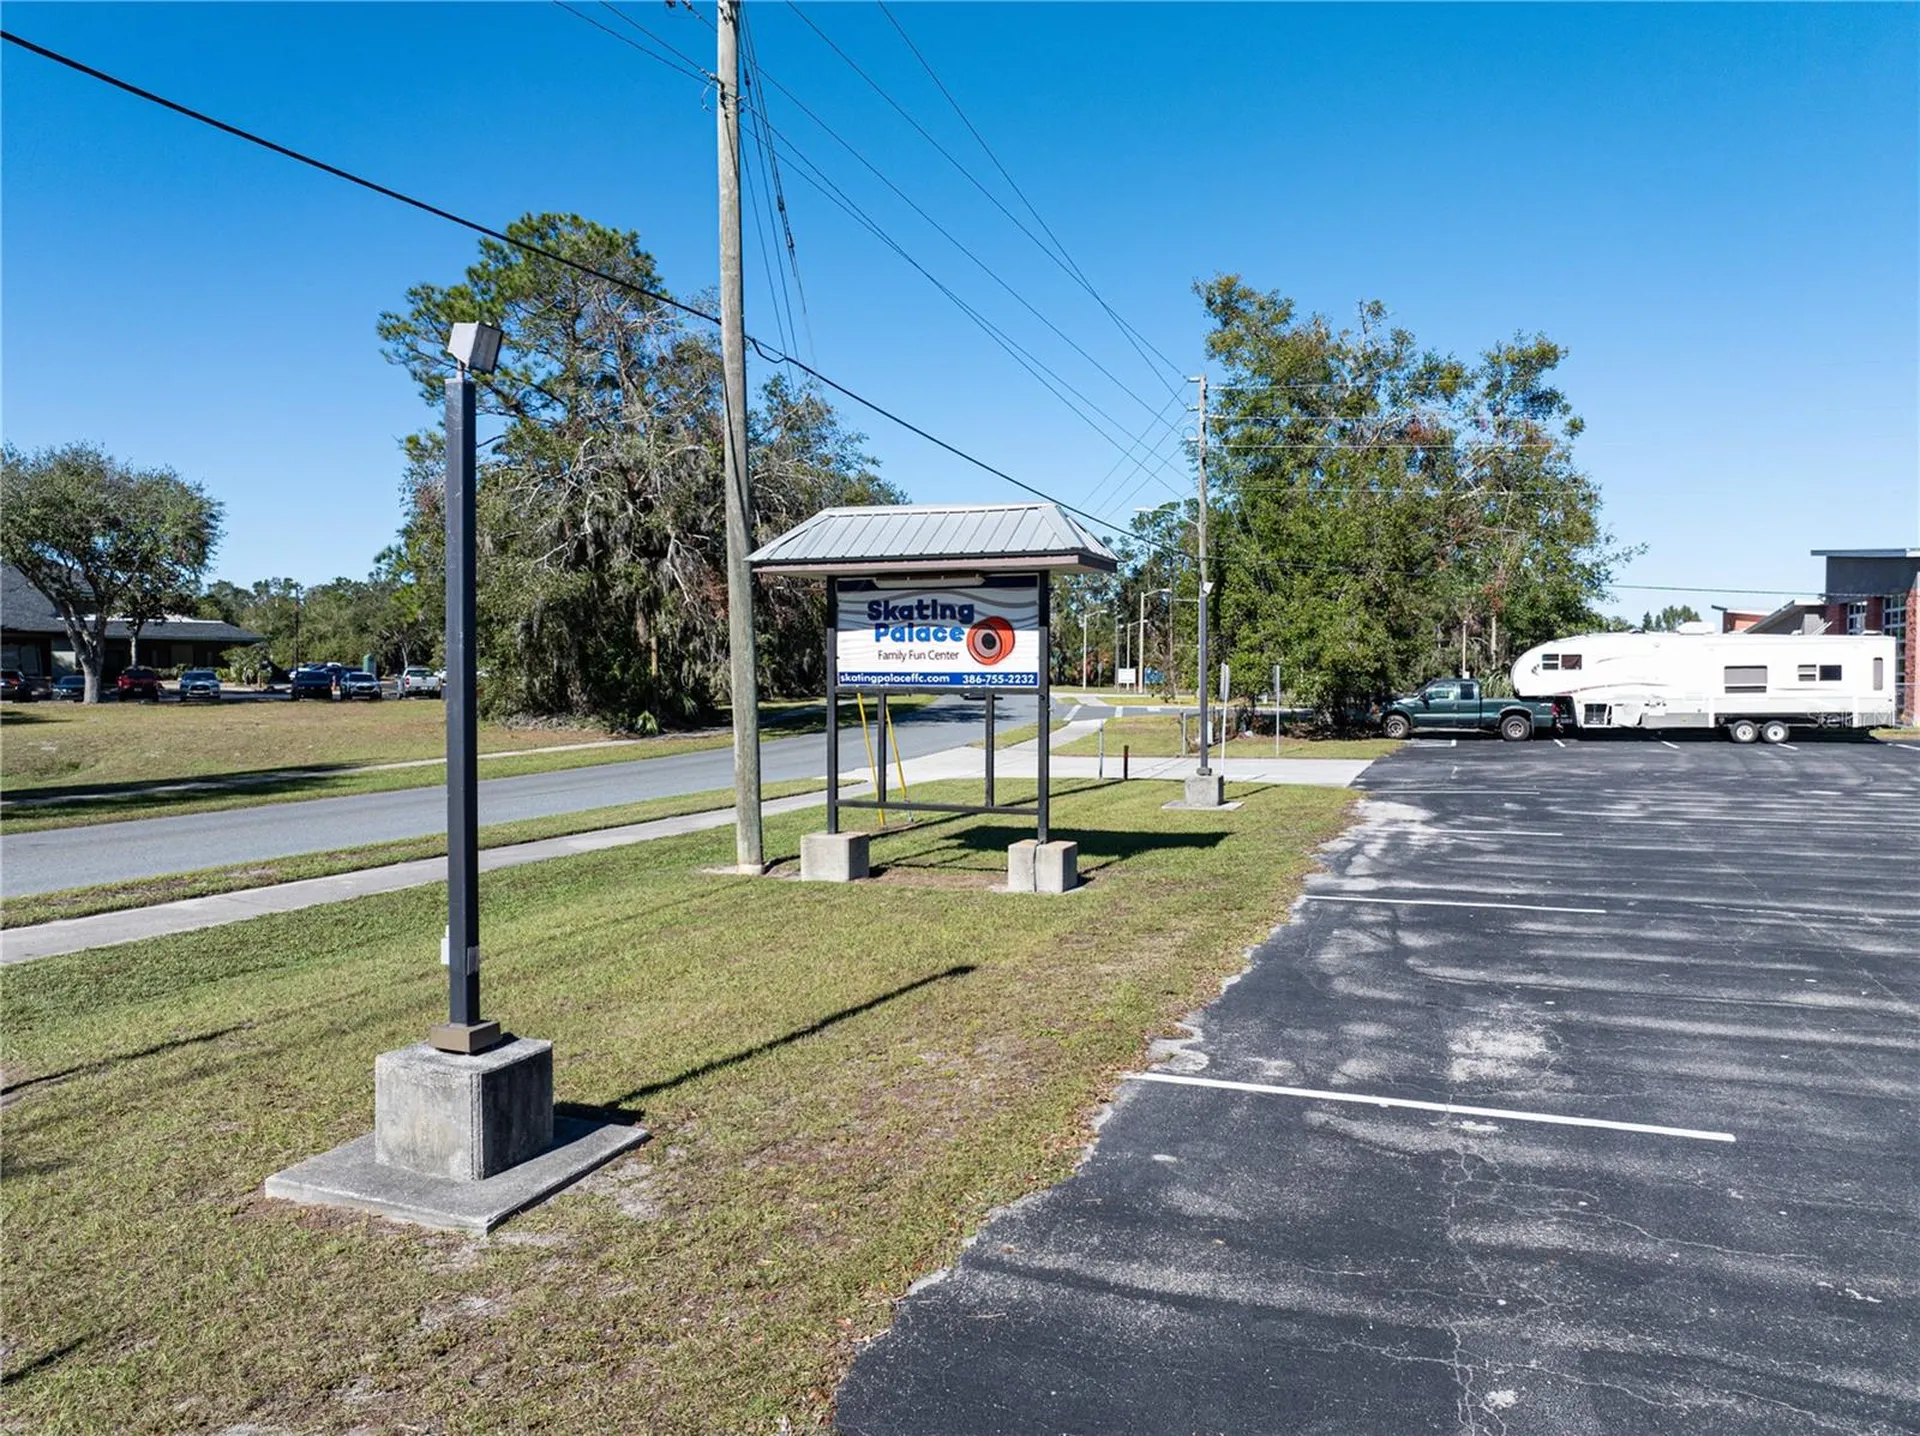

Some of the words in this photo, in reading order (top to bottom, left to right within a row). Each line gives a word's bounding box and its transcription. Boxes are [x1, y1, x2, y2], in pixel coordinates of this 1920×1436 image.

[867, 599, 974, 624] Skating
[875, 623, 965, 642] Palace
[878, 649, 907, 663] Family
[908, 649, 926, 660] Fun
[927, 649, 960, 660] Center
[839, 672, 950, 684] skatingpalaceffc.com
[962, 674, 1035, 684] 386-755-2232
